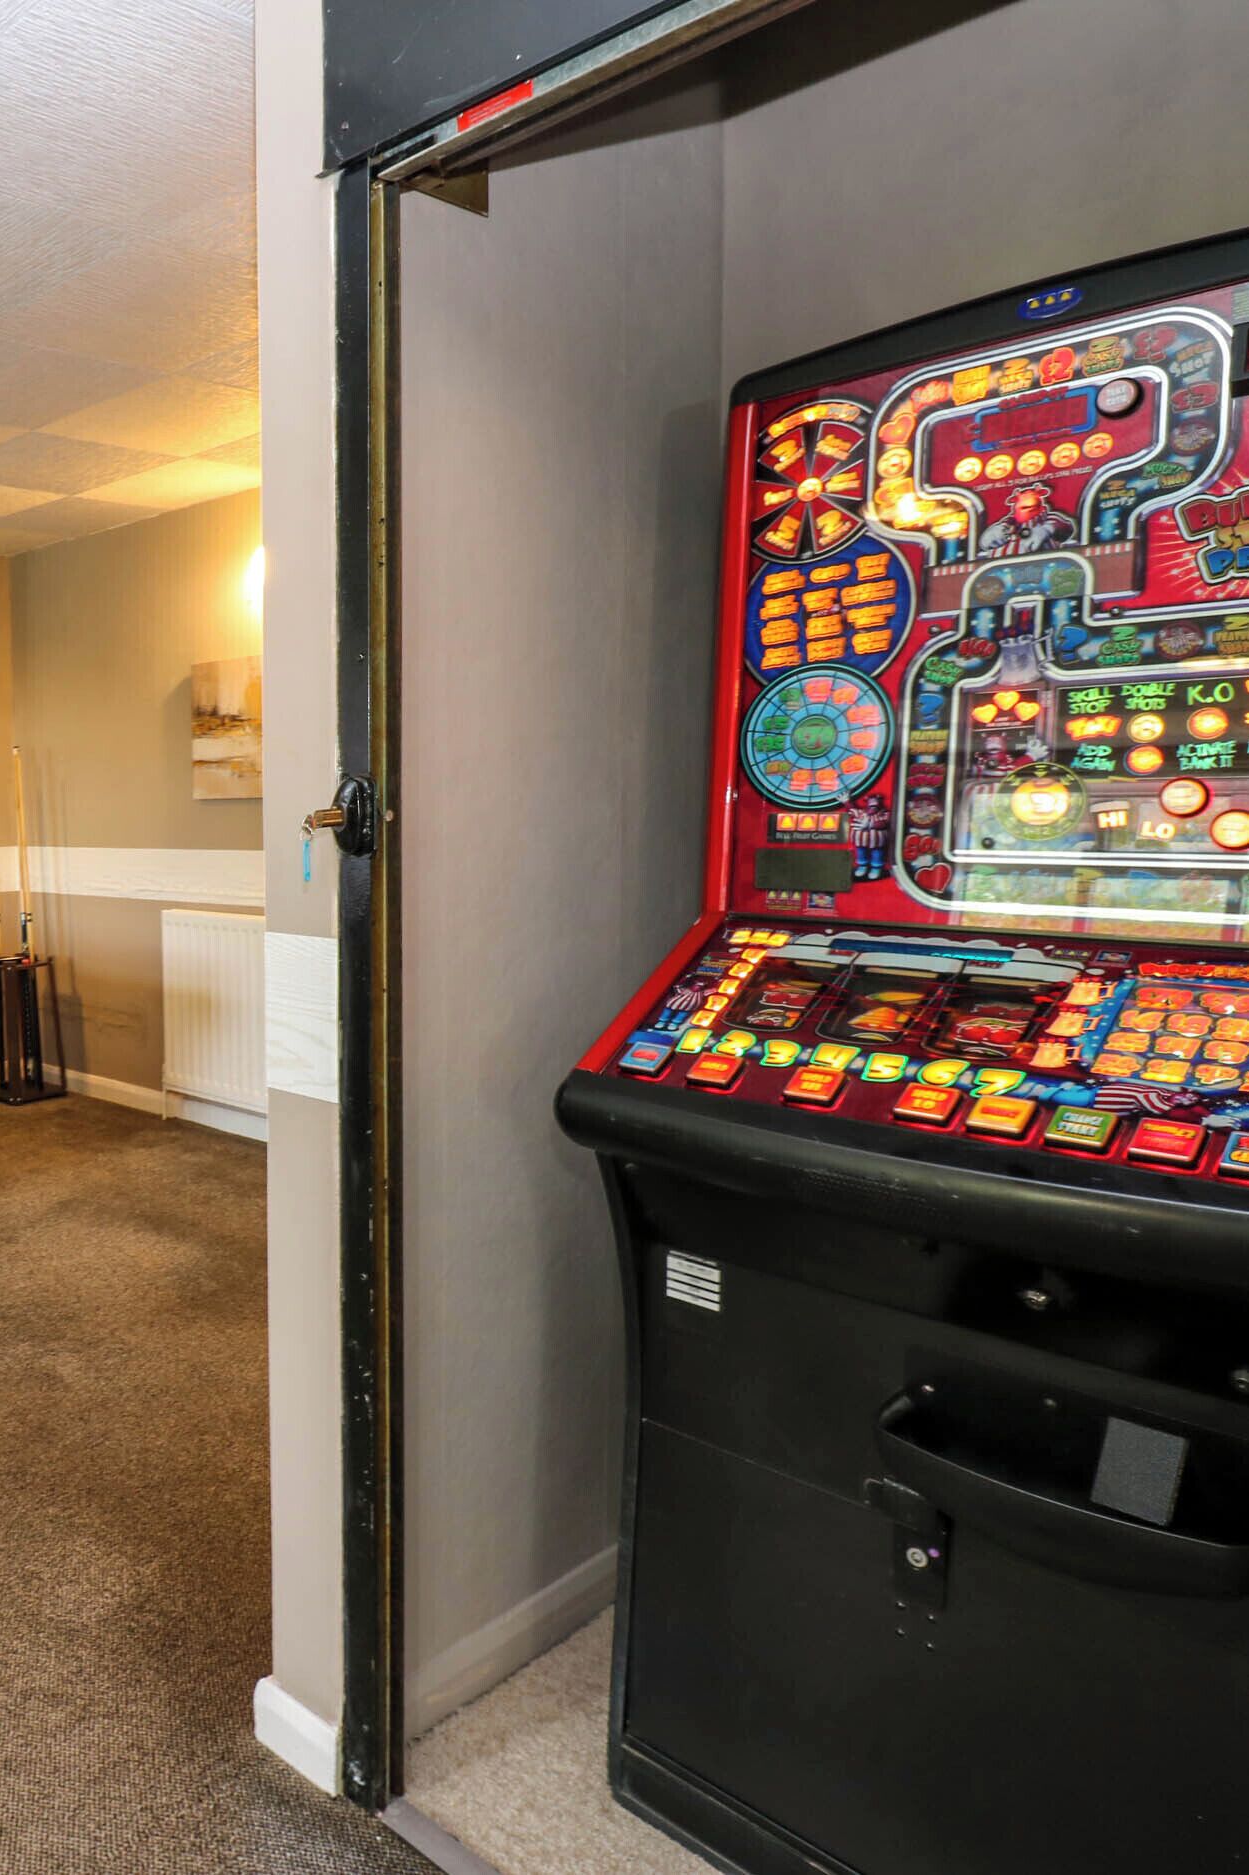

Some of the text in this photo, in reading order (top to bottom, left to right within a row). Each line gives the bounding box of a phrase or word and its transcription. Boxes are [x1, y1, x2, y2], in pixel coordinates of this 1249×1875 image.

[1120, 683, 1176, 698] DOUBLE
[1069, 699, 1112, 715] STOP
[1077, 743, 1113, 757] ADD
[1070, 757, 1117, 772] AGAIN
[1098, 811, 1129, 829] HI
[1140, 821, 1177, 840] LO
[676, 1028, 713, 1054] 1
[712, 1029, 758, 1056] 2
[759, 1039, 802, 1067] 3
[810, 1042, 862, 1072] 4
[861, 1050, 909, 1083] 5
[917, 1058, 971, 1088] 6
[969, 1067, 1027, 1098] 7
